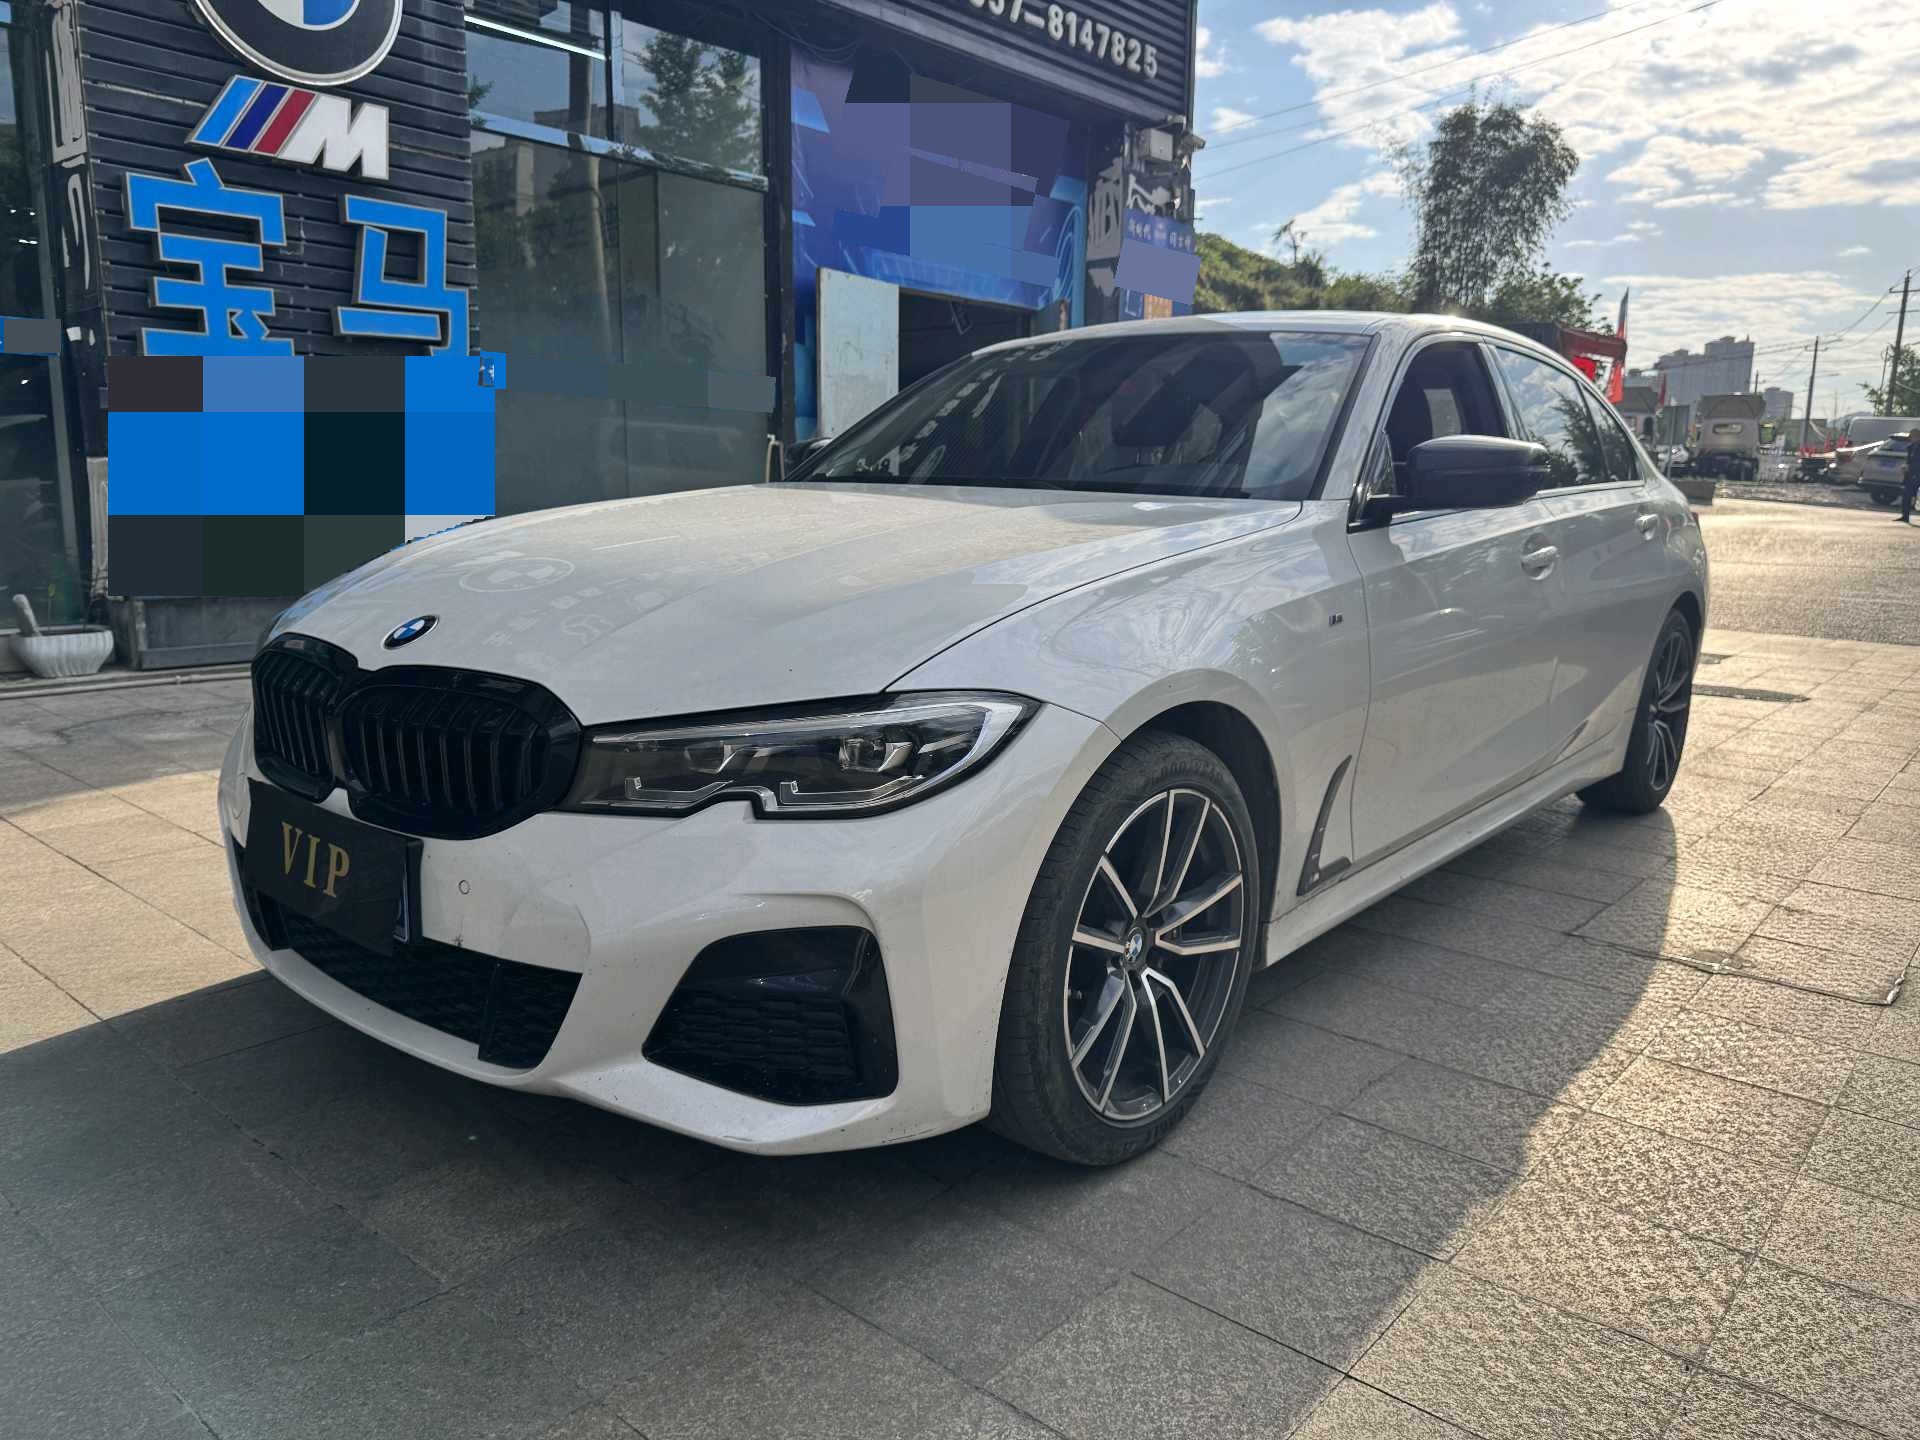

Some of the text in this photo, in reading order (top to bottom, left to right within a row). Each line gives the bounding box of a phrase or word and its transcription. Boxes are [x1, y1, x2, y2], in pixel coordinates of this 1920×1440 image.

[968, 0, 1158, 79] 7-8147825
[125, 156, 471, 356] 宝马
[281, 821, 350, 898] VIP
